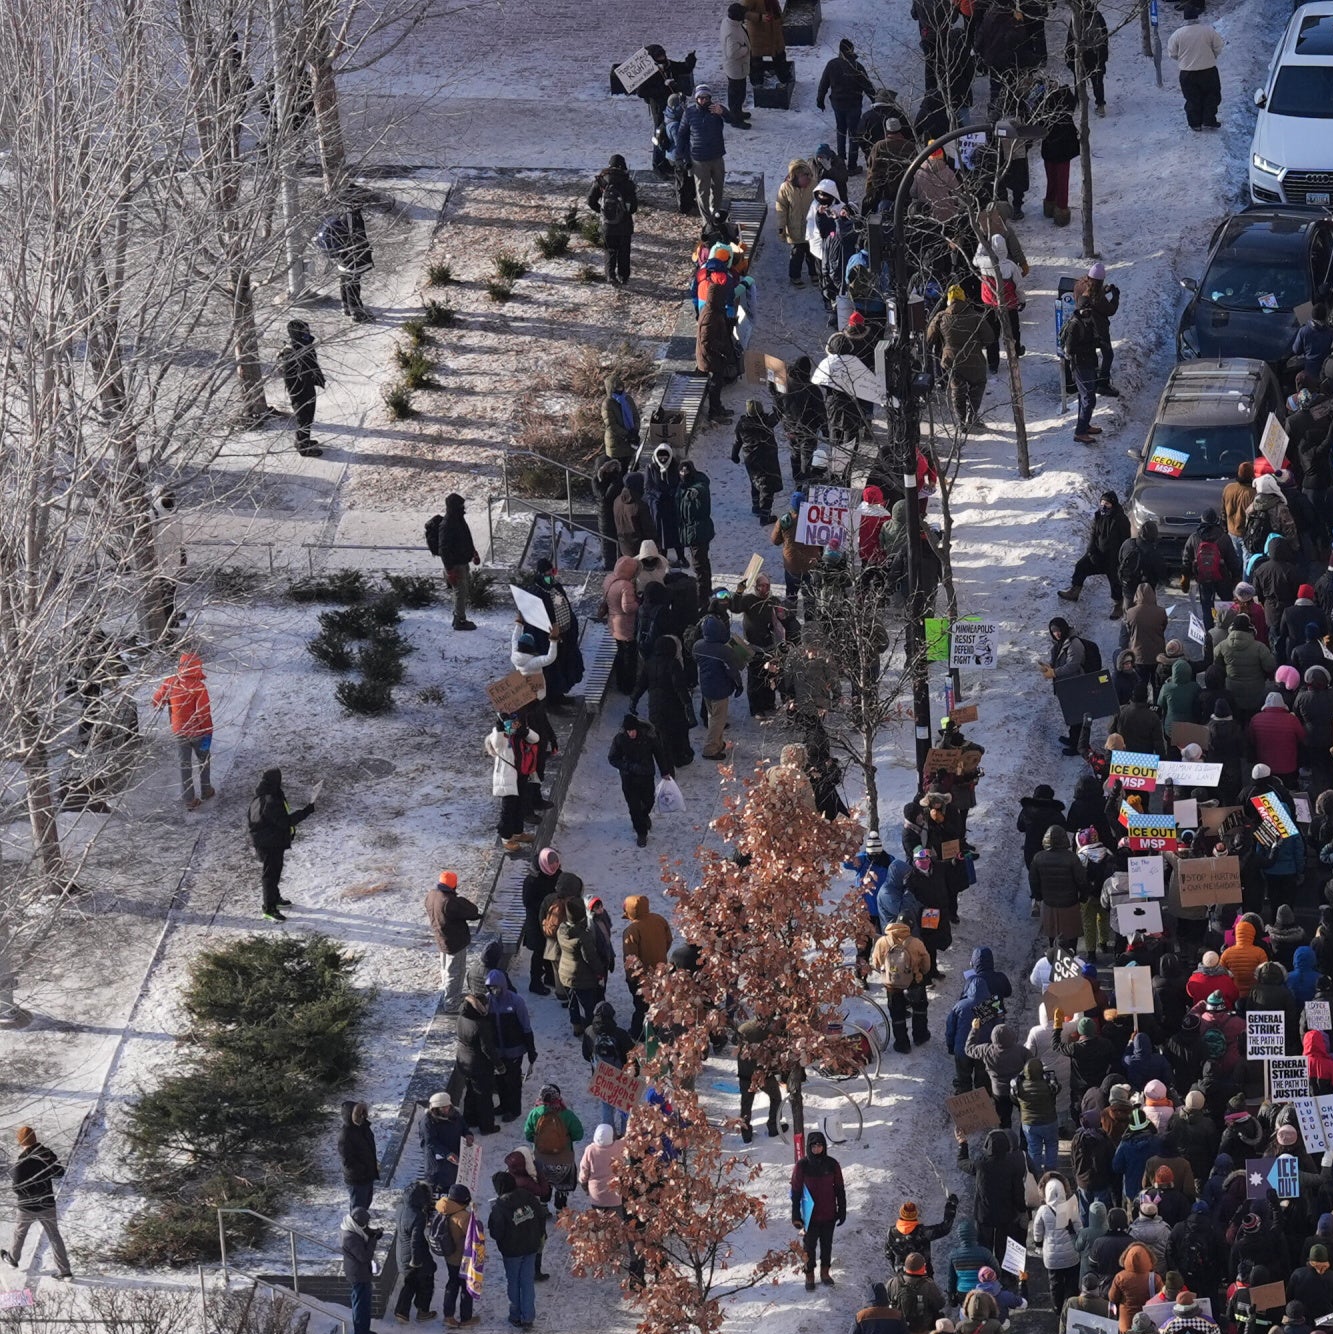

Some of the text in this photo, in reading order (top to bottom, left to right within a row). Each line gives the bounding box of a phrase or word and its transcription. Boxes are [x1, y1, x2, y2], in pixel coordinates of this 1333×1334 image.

[1152, 455, 1185, 469] ICE OUT
[1154, 464, 1173, 473] MSP
[807, 504, 848, 525] OUT
[955, 635, 976, 644] RESIST
[955, 645, 974, 654] DEFEND
[954, 655, 971, 665] FIGHT
[1110, 764, 1129, 775] ICE
[1132, 766, 1157, 778] OUT
[1120, 776, 1146, 789] MSP
[1259, 795, 1288, 838] ICE OUT
[1129, 827, 1174, 837] ICE OUT
[1139, 839, 1165, 849] MSP
[1248, 1014, 1283, 1024] GENERAL
[1248, 1024, 1283, 1034] STRIKE:
[1248, 1045, 1283, 1056] JUSTICE
[1272, 1059, 1307, 1069] GENERAL
[1272, 1069, 1307, 1079] STRIKE:
[1273, 1088, 1308, 1099] JUSTICE
[1278, 1158, 1297, 1177] ICE
[1278, 1178, 1297, 1197] OUT
